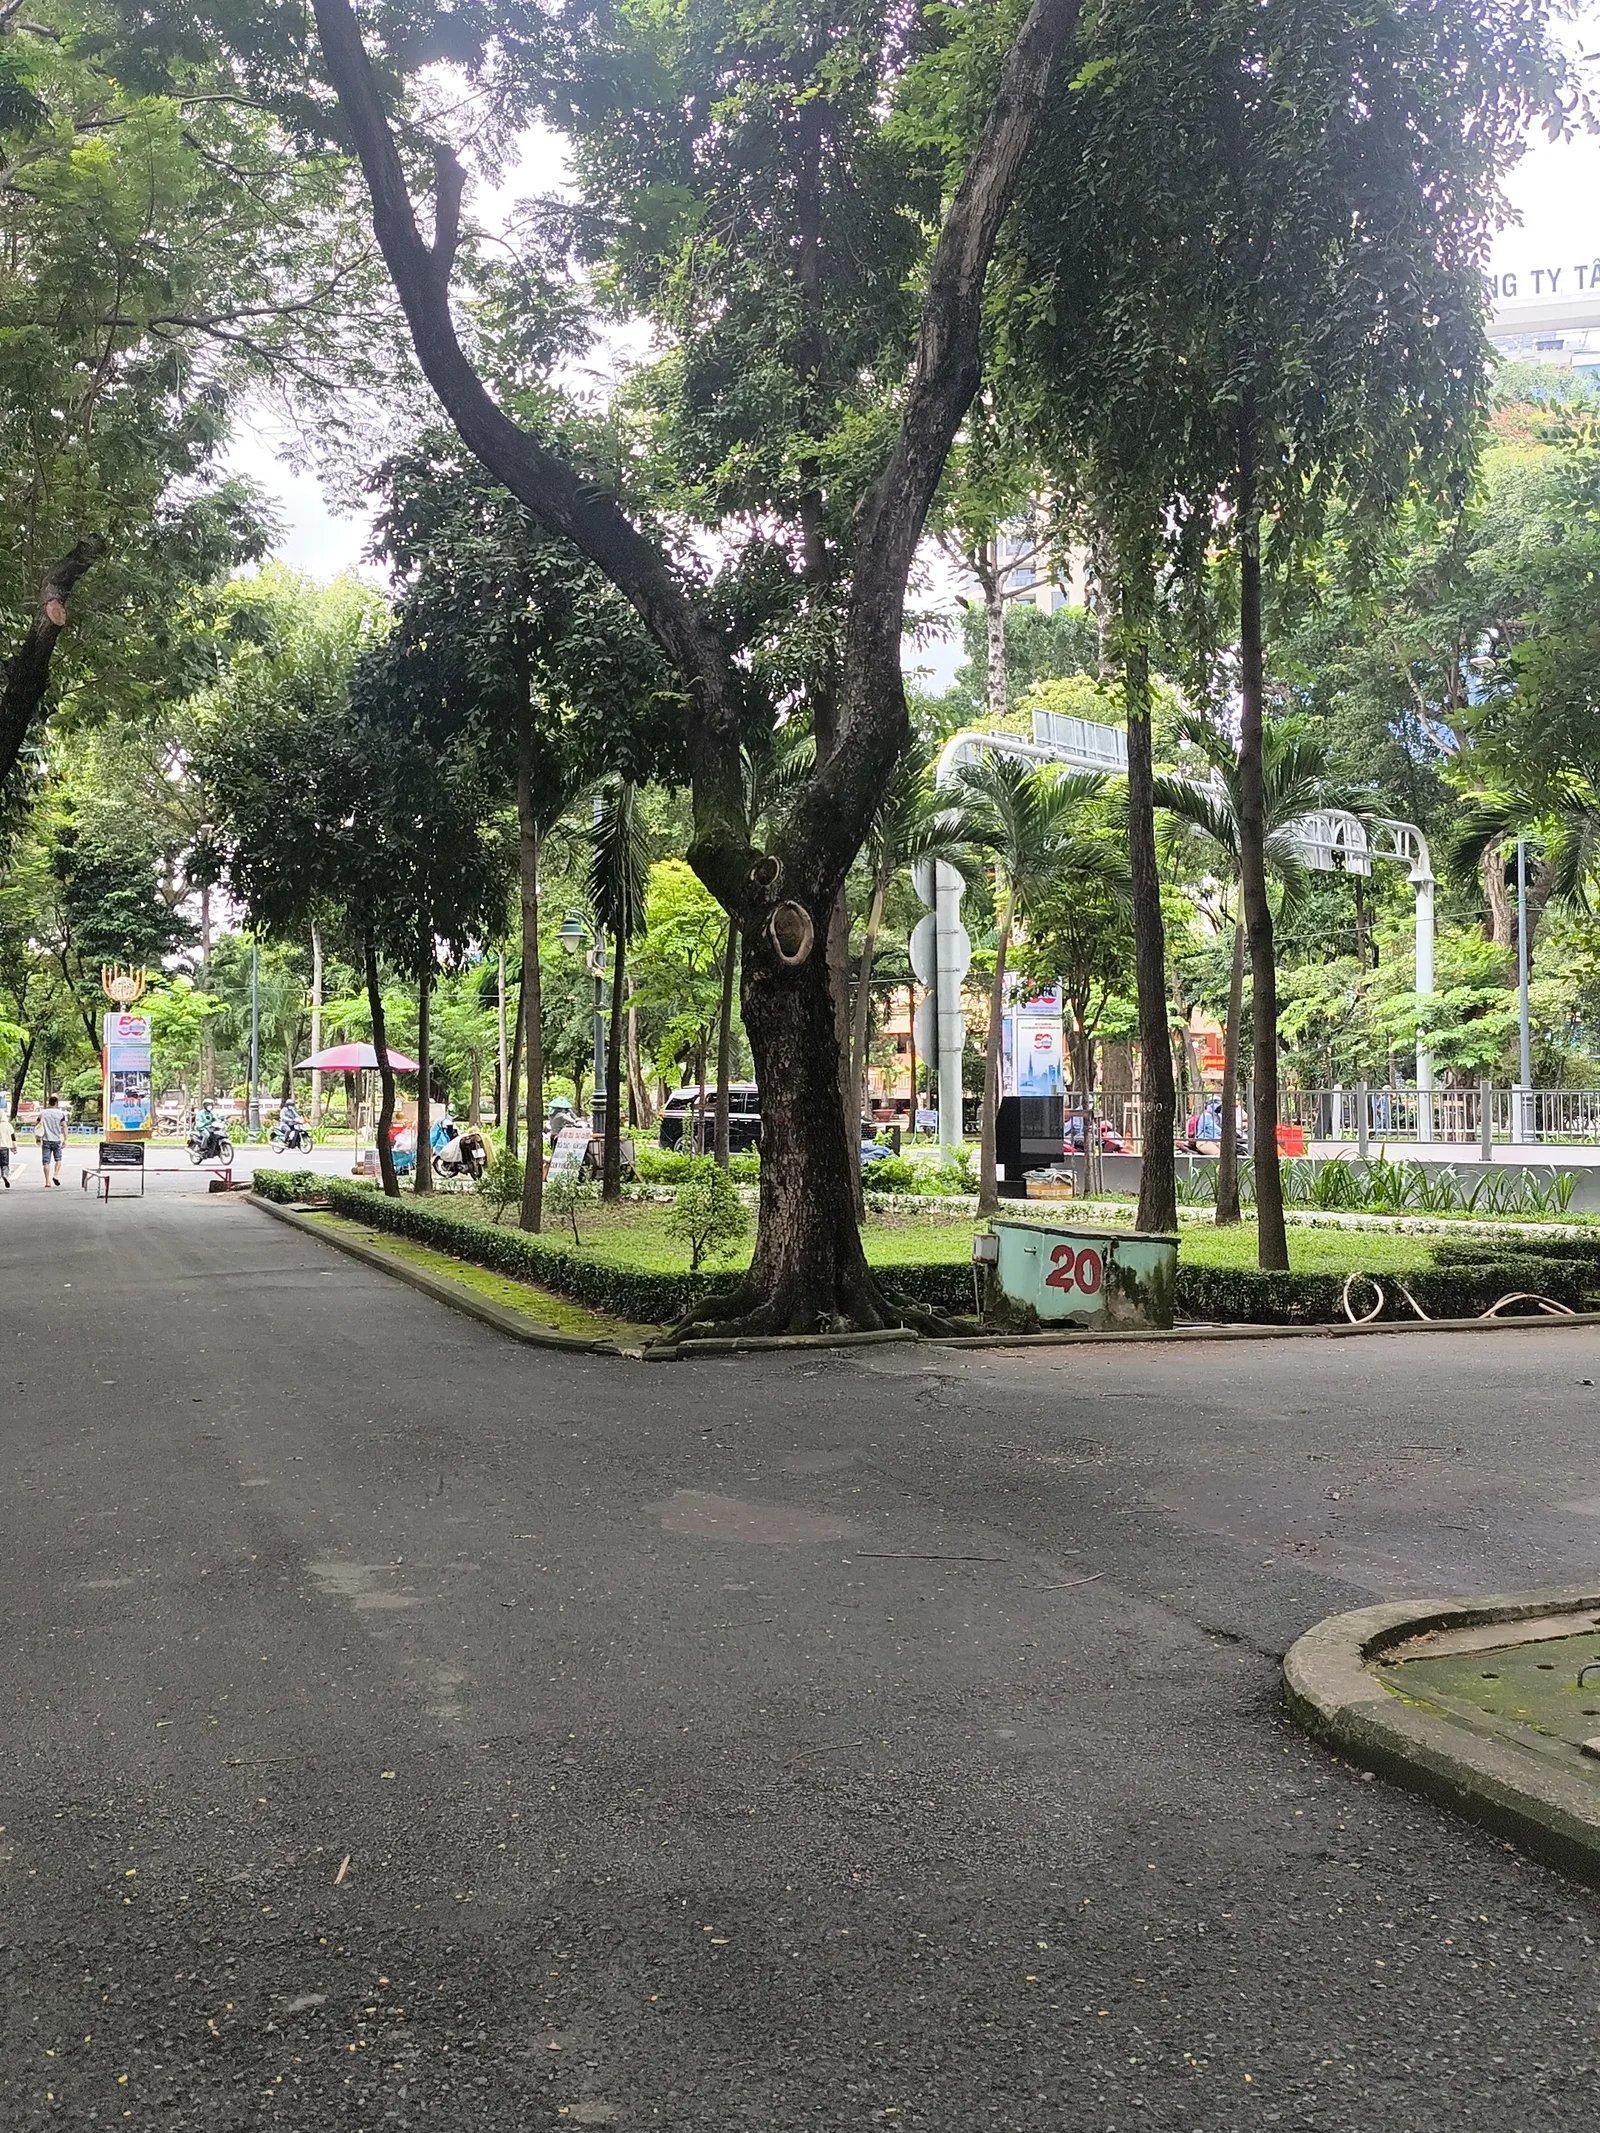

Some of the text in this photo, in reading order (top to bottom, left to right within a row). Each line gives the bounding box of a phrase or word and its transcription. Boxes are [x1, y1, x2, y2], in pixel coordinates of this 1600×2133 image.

[1530, 268, 1561, 294] TY
[1034, 1033, 1053, 1049] 50
[1046, 1245, 1101, 1294] 20
